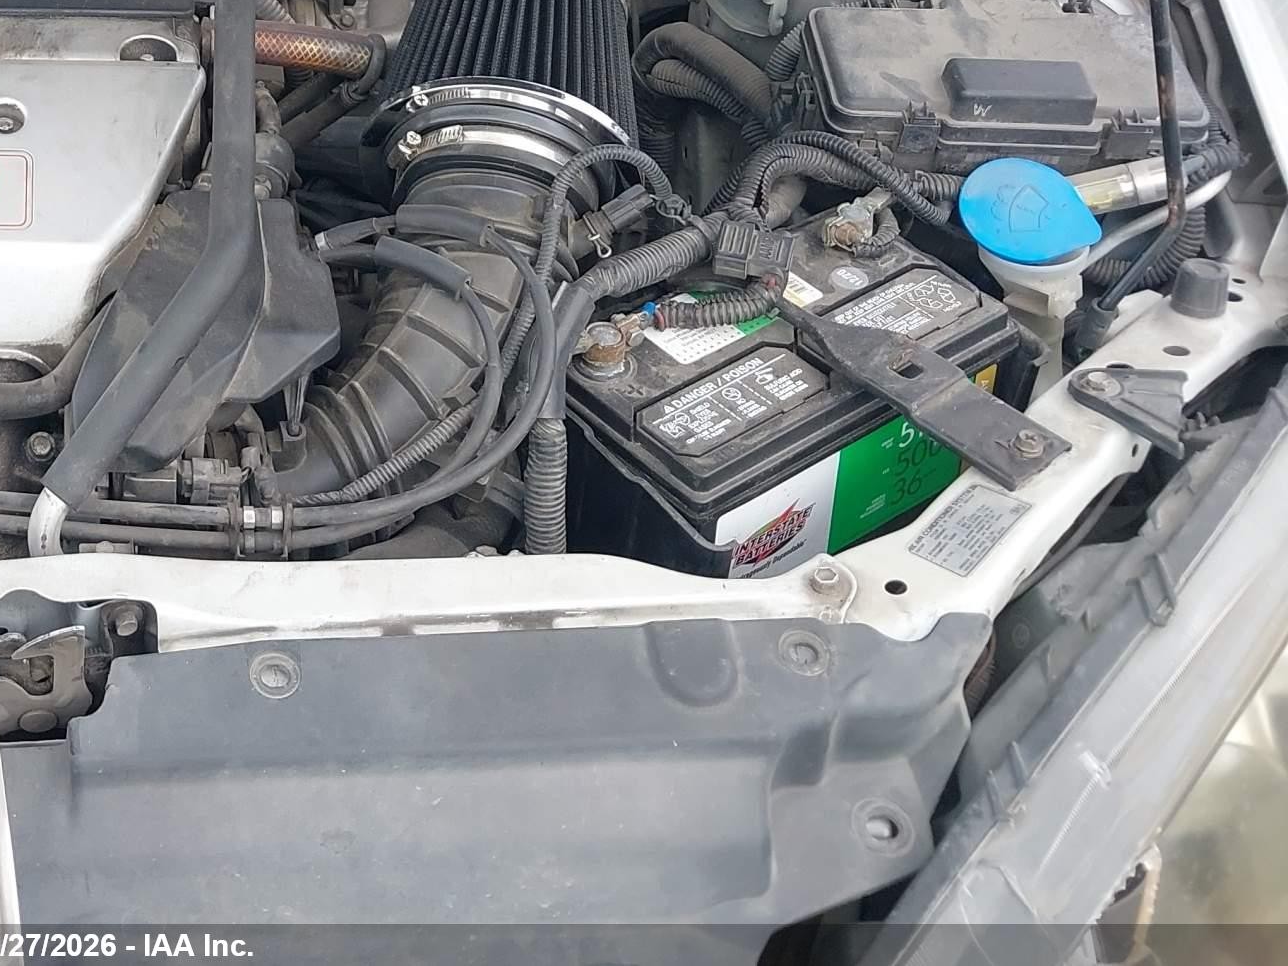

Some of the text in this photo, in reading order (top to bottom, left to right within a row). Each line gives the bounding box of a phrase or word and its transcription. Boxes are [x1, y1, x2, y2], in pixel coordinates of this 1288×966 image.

[671, 380, 718, 409] DANGER
[724, 357, 764, 382] POISON
[890, 468, 922, 506] 36
[734, 505, 813, 556] INTERSTATE
[735, 520, 806, 566] BATTERIES
